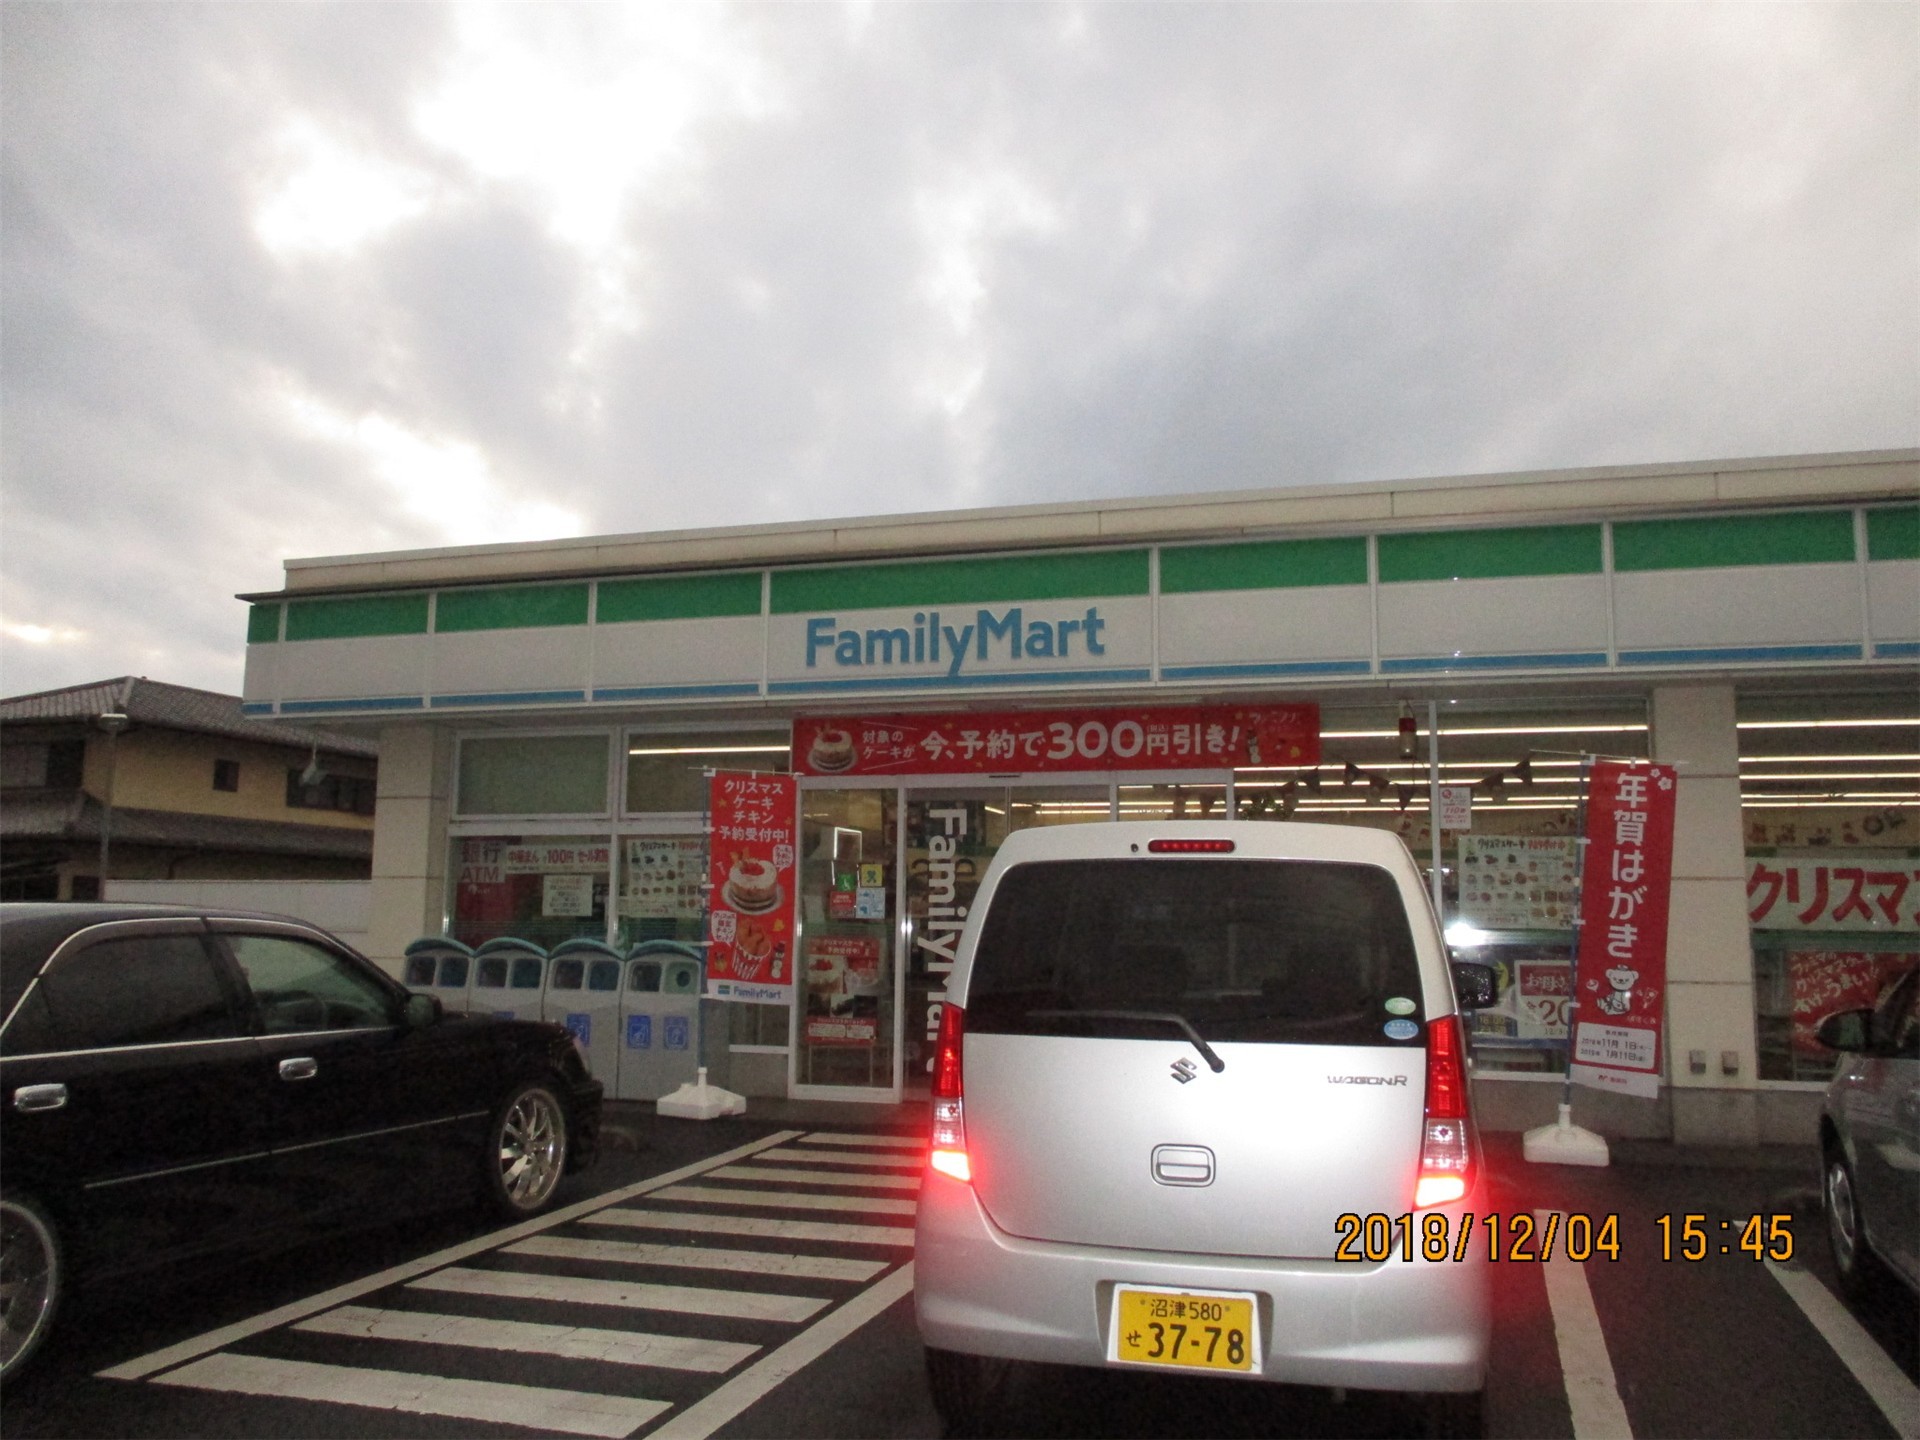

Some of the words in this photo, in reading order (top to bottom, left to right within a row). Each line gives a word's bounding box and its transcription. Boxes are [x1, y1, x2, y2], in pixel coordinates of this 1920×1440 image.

[806, 607, 1105, 677] FamilyMart
[862, 729, 904, 744] 対象の
[863, 745, 915, 759] ケーキが
[724, 779, 783, 795] クリスマス
[733, 795, 774, 810] ケーキ
[733, 810, 774, 825] チキン
[719, 826, 789, 844] 予約受付中!
[1605, 772, 1648, 959] 年賀はがき
[461, 866, 499, 881] ATM
[1746, 863, 1920, 925] クリスマ
[733, 985, 781, 999] FamilyMart
[1126, 1330, 1142, 1347] せ
[1148, 1322, 1245, 1365] 37-78
